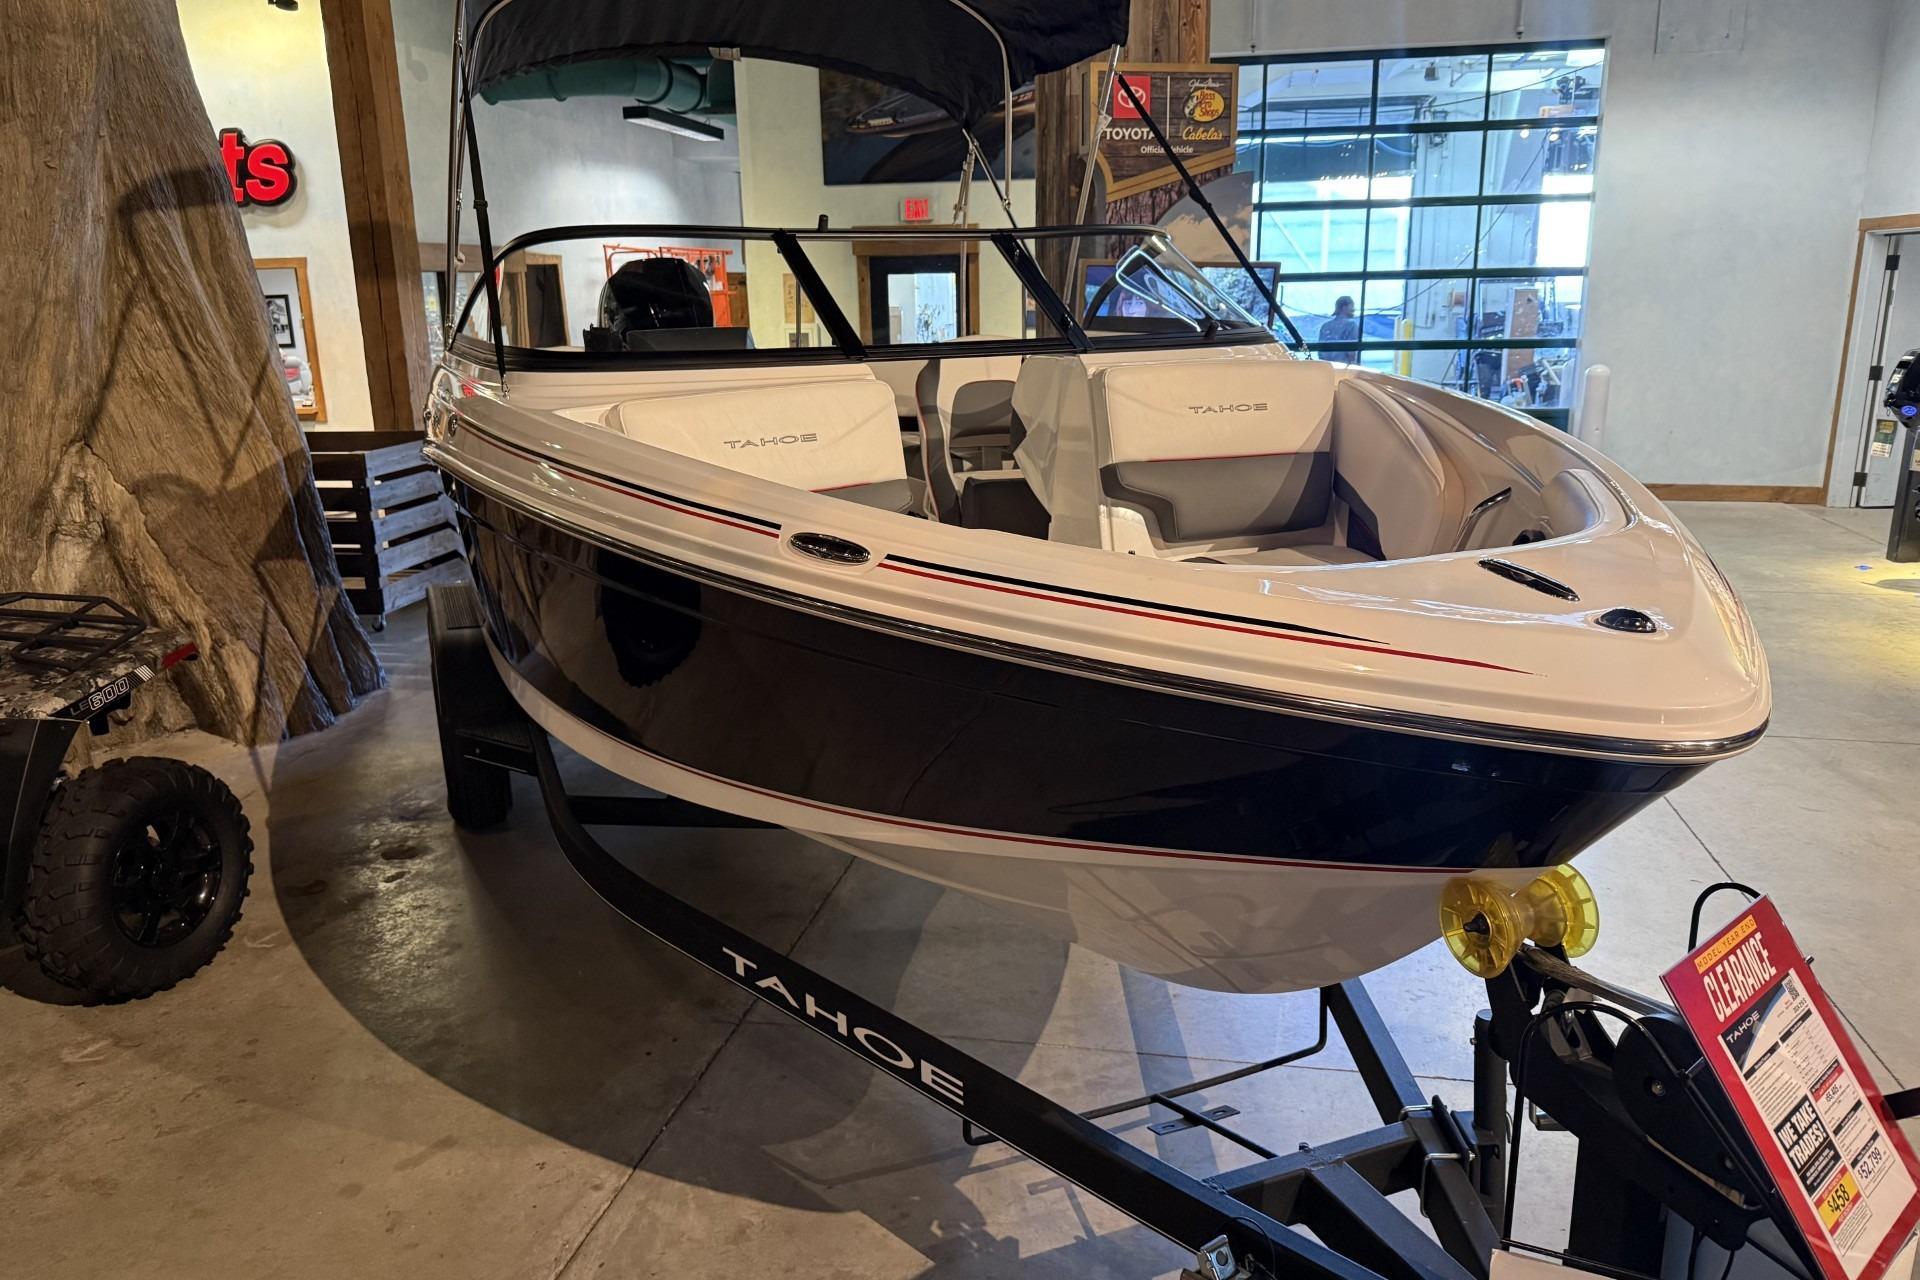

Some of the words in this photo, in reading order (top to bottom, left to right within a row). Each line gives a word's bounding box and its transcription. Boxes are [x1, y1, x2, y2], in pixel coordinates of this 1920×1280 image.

[1103, 127, 1156, 140] TOYOTA
[1140, 145, 1166, 154] Officia
[905, 198, 929, 219] EXIT
[1188, 402, 1269, 414] TAHOE
[723, 432, 818, 449] TAHOE
[88, 677, 130, 711] 600
[1697, 947, 1722, 968] MODEL
[1722, 930, 1740, 947] YEAR
[1741, 918, 1755, 933] END
[1703, 931, 1777, 1023] CLEARANCE
[722, 946, 964, 1106] TAHOE
[1726, 1010, 1760, 1043] TAHOE
[1777, 1121, 1799, 1150] WE
[1790, 1100, 1817, 1135] TAKE
[1788, 1119, 1827, 1170] TRADES!
[1857, 1146, 1882, 1179] $52,799
[1827, 1183, 1850, 1213] $458
